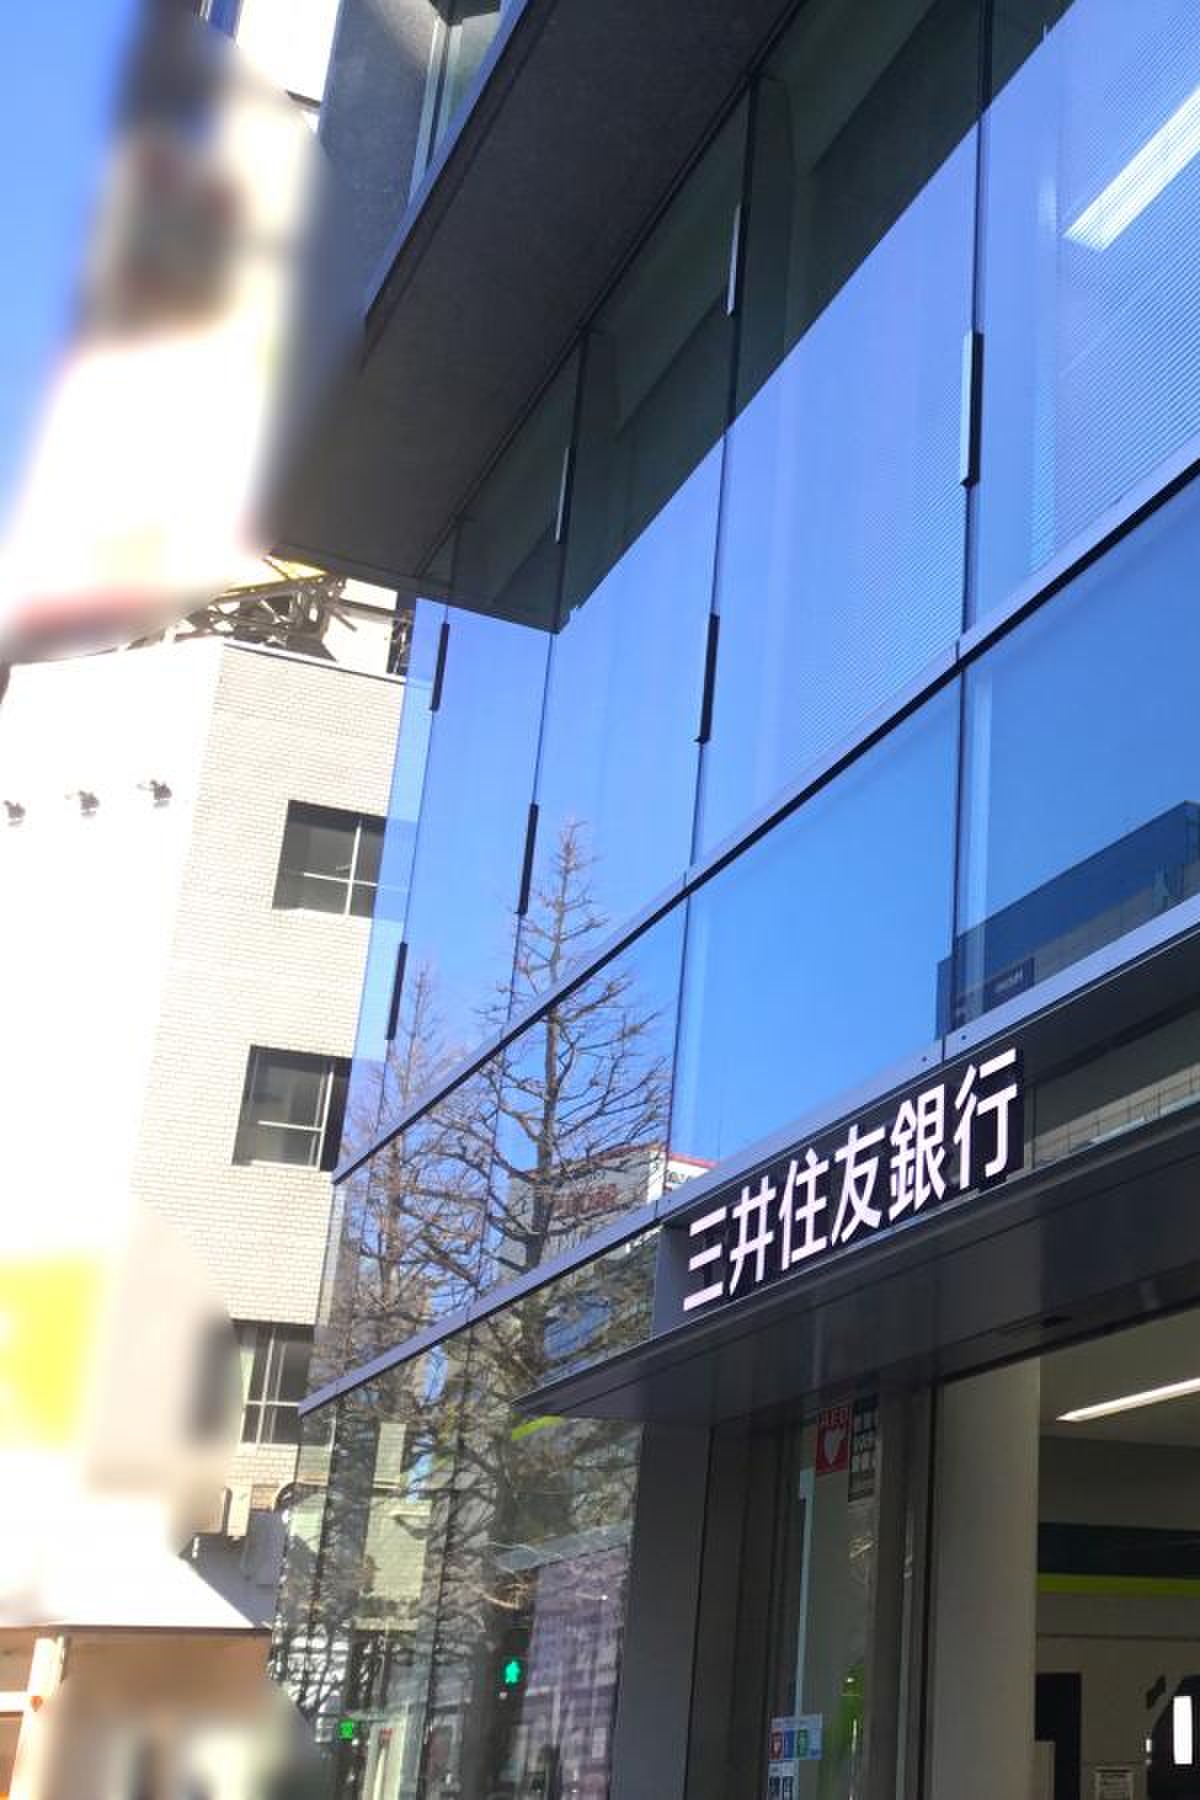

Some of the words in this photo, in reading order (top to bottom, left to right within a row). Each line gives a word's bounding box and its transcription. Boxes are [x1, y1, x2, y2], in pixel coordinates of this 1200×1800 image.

[683, 1047, 1018, 1311] 三井住友銀行
